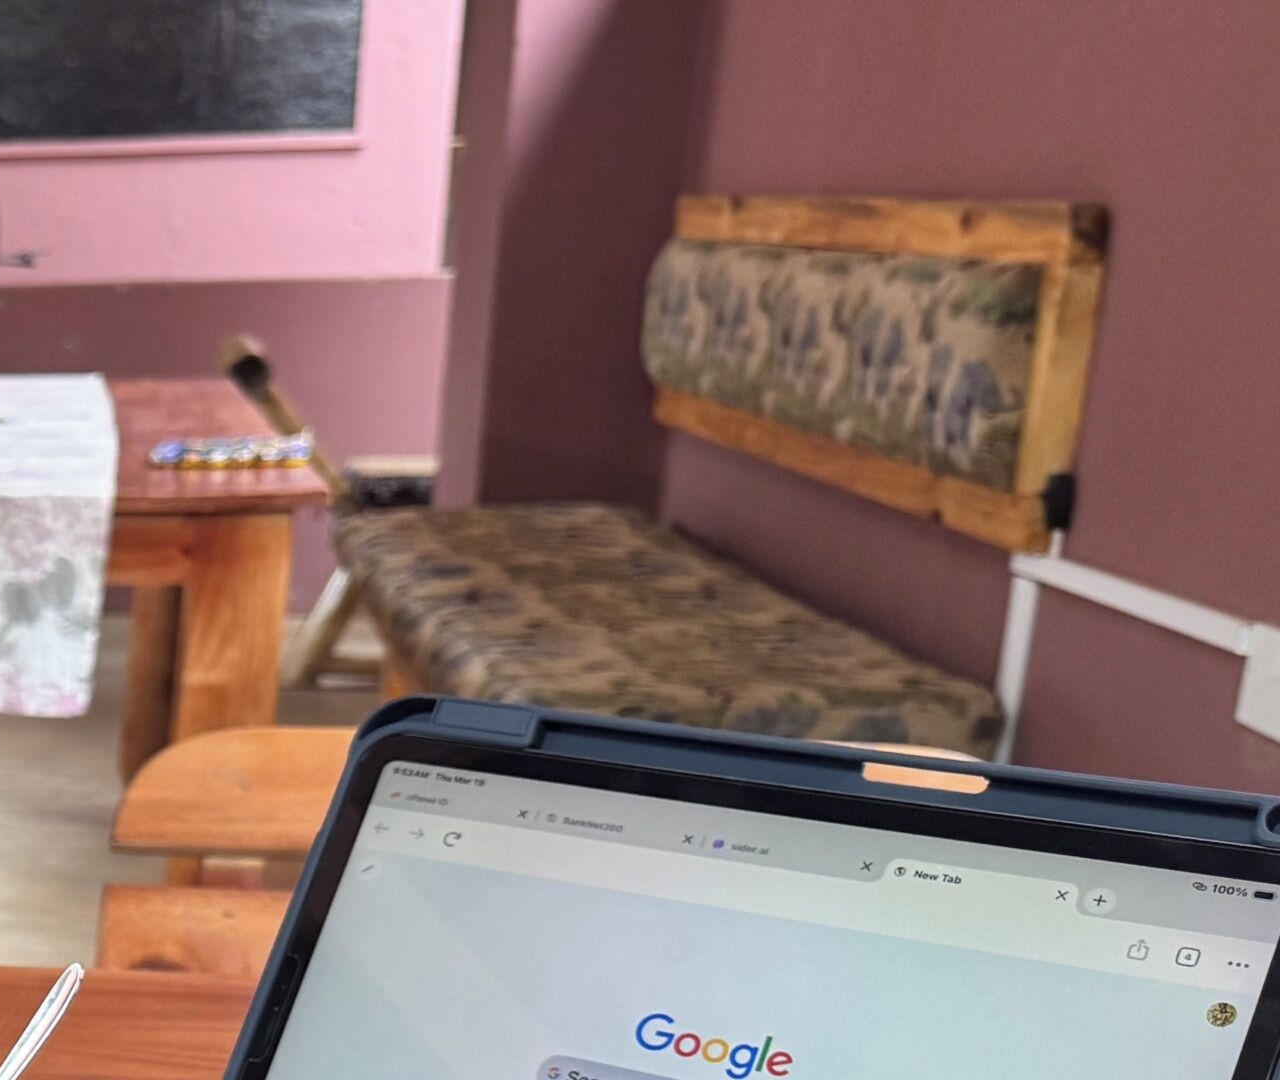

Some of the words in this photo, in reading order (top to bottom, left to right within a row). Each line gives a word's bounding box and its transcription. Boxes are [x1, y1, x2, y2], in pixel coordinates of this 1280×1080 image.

[914, 869, 939, 881] New
[942, 873, 962, 885] Tab
[1212, 884, 1248, 898] 100%
[635, 1013, 794, 1080] Google
